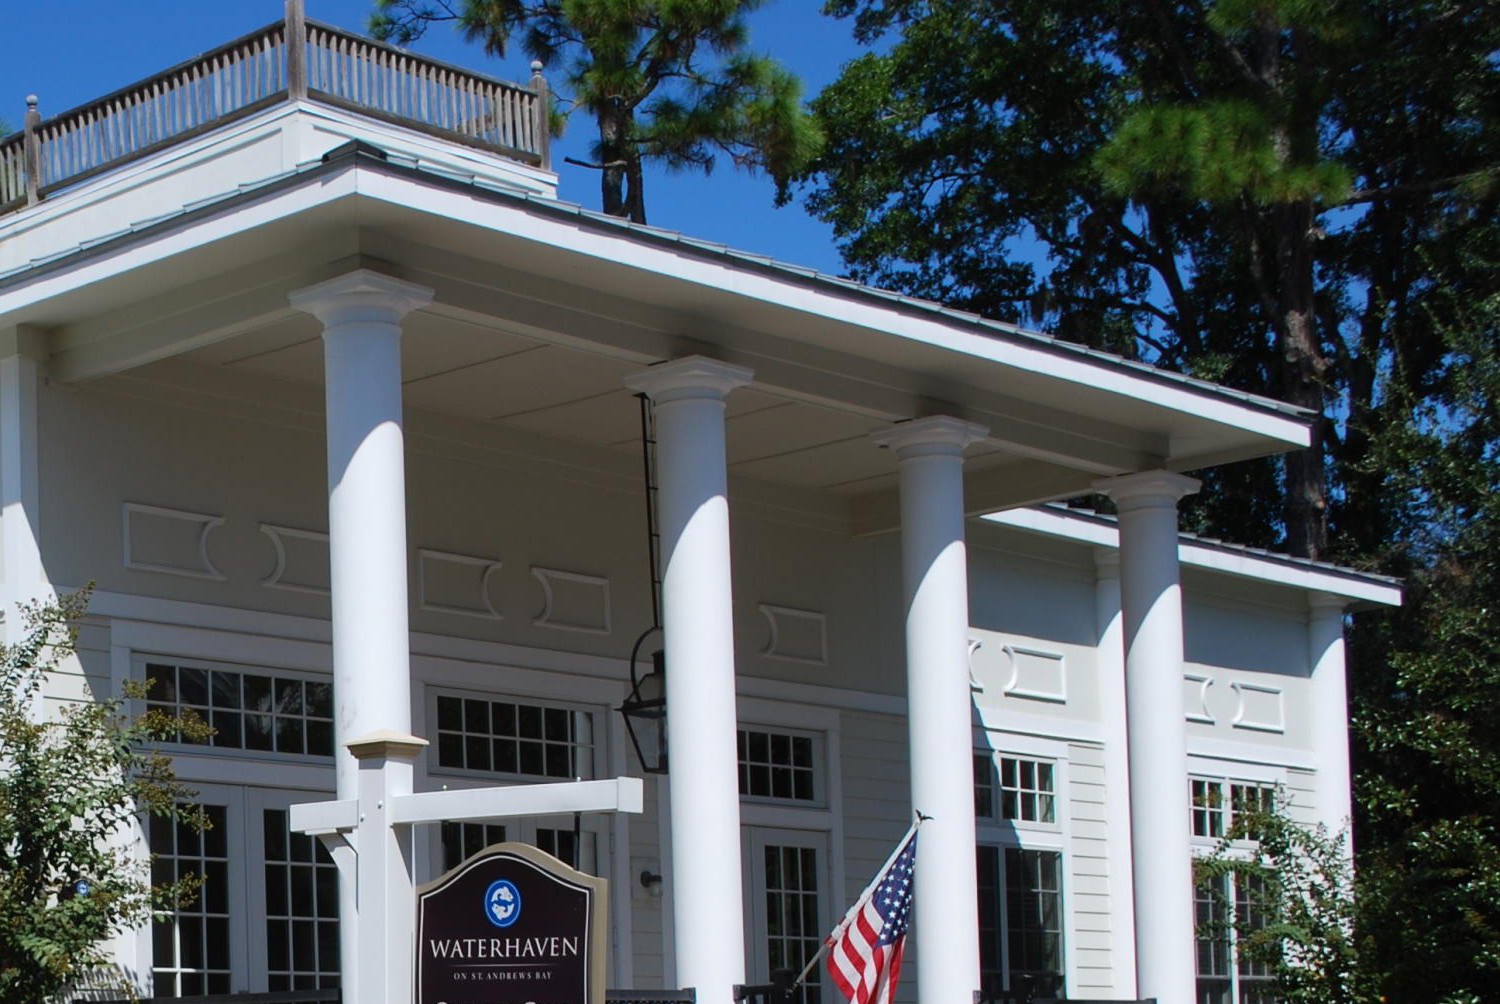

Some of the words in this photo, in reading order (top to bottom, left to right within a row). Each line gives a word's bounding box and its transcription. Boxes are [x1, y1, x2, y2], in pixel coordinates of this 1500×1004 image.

[430, 936, 579, 959] WATERHAVEN
[453, 972, 468, 981] ON
[487, 971, 532, 981] ANDREWS
[535, 971, 553, 981] BAY
